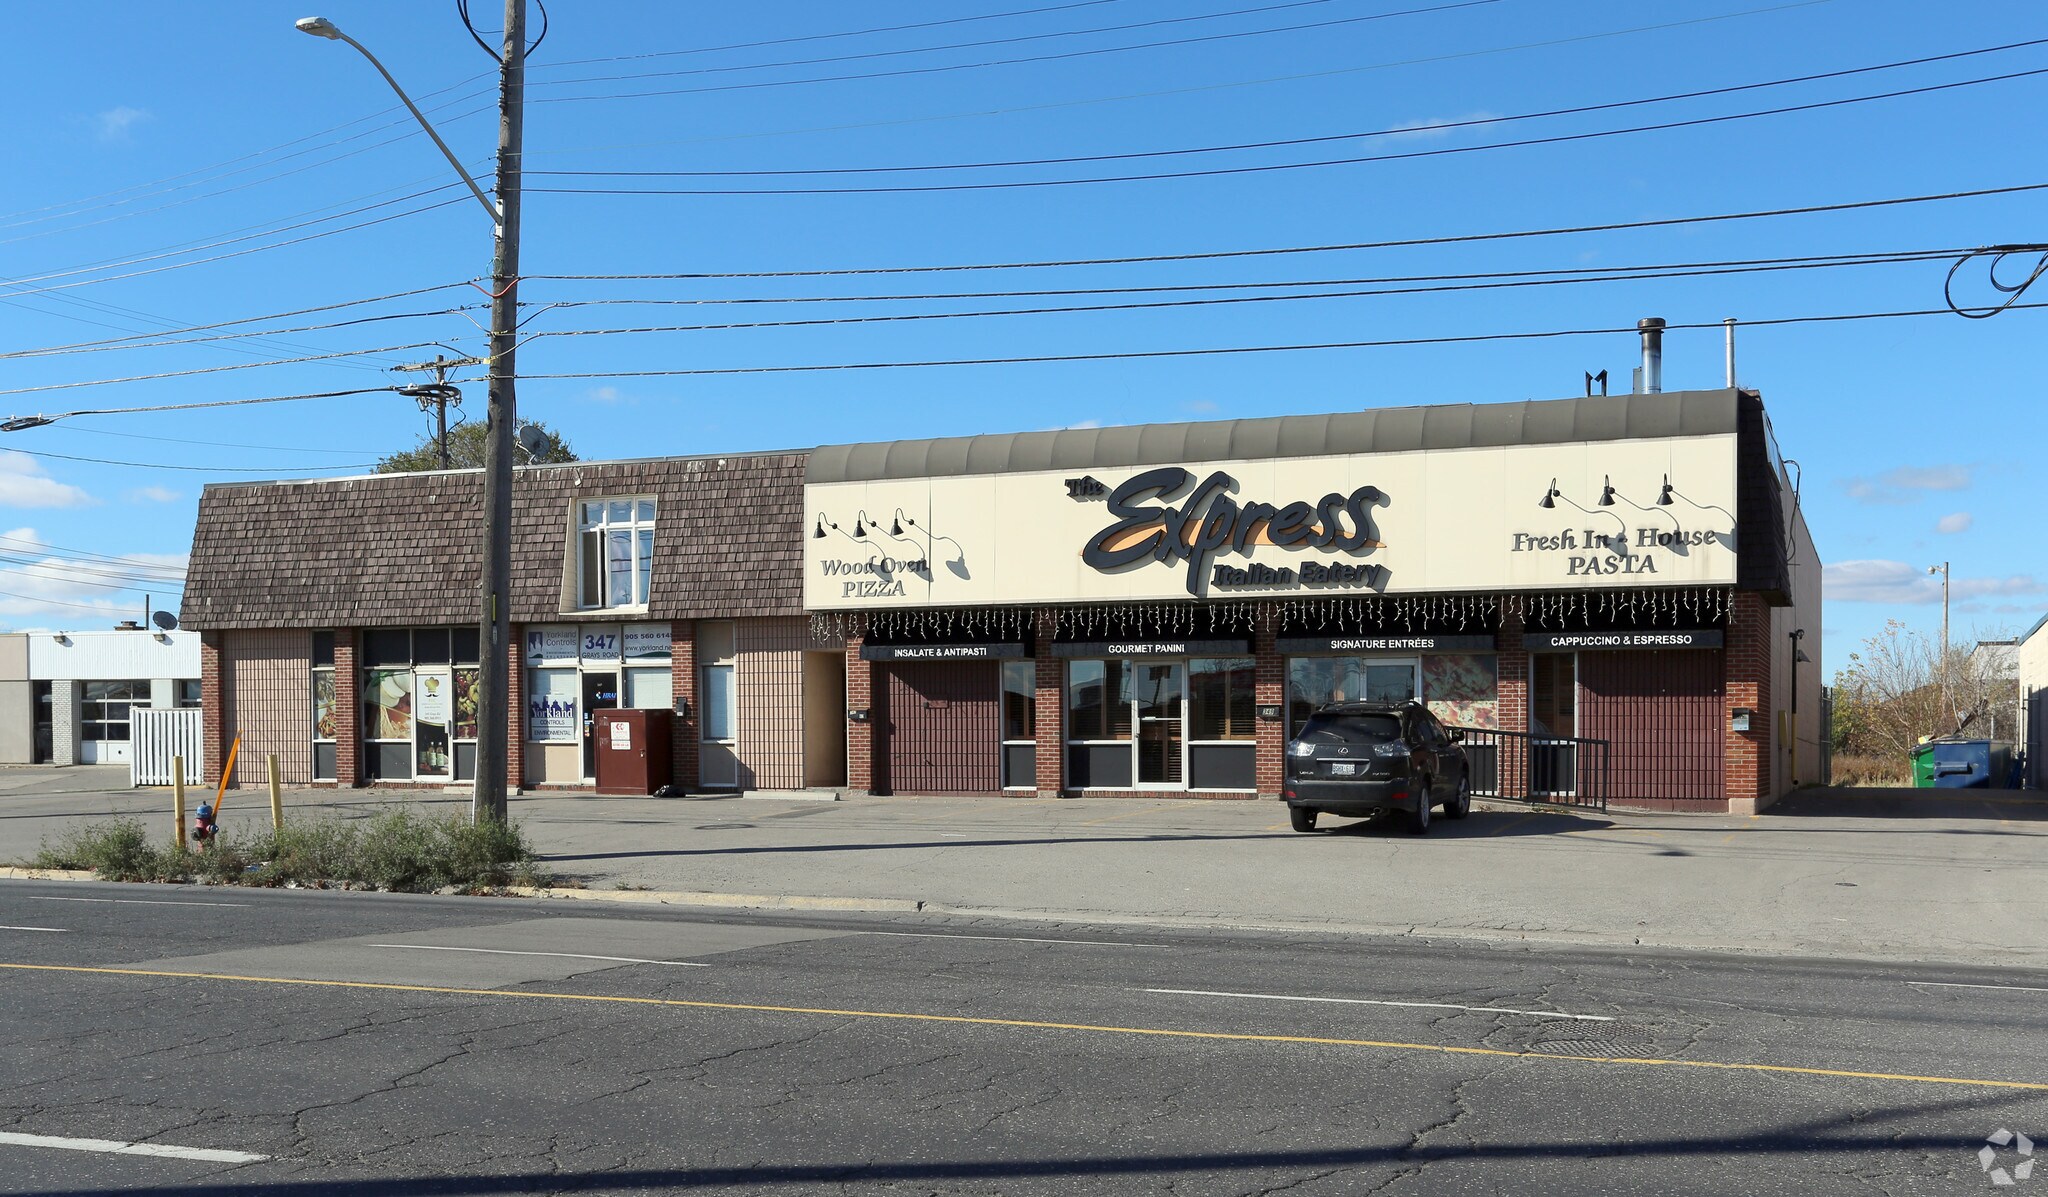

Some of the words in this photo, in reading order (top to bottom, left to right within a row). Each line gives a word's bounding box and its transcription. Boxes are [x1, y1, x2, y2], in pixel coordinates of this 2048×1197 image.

[1064, 476, 1104, 497] The
[1082, 467, 1381, 594] Express
[1511, 528, 1577, 552] Fresh
[1582, 530, 1611, 549] In
[1636, 528, 1716, 548] House
[820, 555, 877, 576] Wood
[880, 557, 929, 574] Oven
[1567, 554, 1658, 575] PASTA
[1211, 563, 1291, 586] Italian
[1299, 561, 1381, 586] Eatery
[841, 580, 907, 598] PIZZA
[546, 638, 577, 646] Controls
[585, 634, 616, 650] 347
[1108, 644, 1153, 654] GOURMET
[1155, 643, 1185, 653] PANINI
[1330, 639, 1386, 649] SIGNATURE
[1388, 637, 1435, 648] ENTRÉES
[1551, 636, 1621, 646] CAPPUCCINO
[1623, 635, 1631, 645] &
[1633, 634, 1692, 645] ESPRESSO
[894, 648, 935, 657] INSALATE
[936, 647, 943, 657] &
[944, 647, 987, 656] ANTIPASTI
[532, 707, 573, 718] Yorkland
